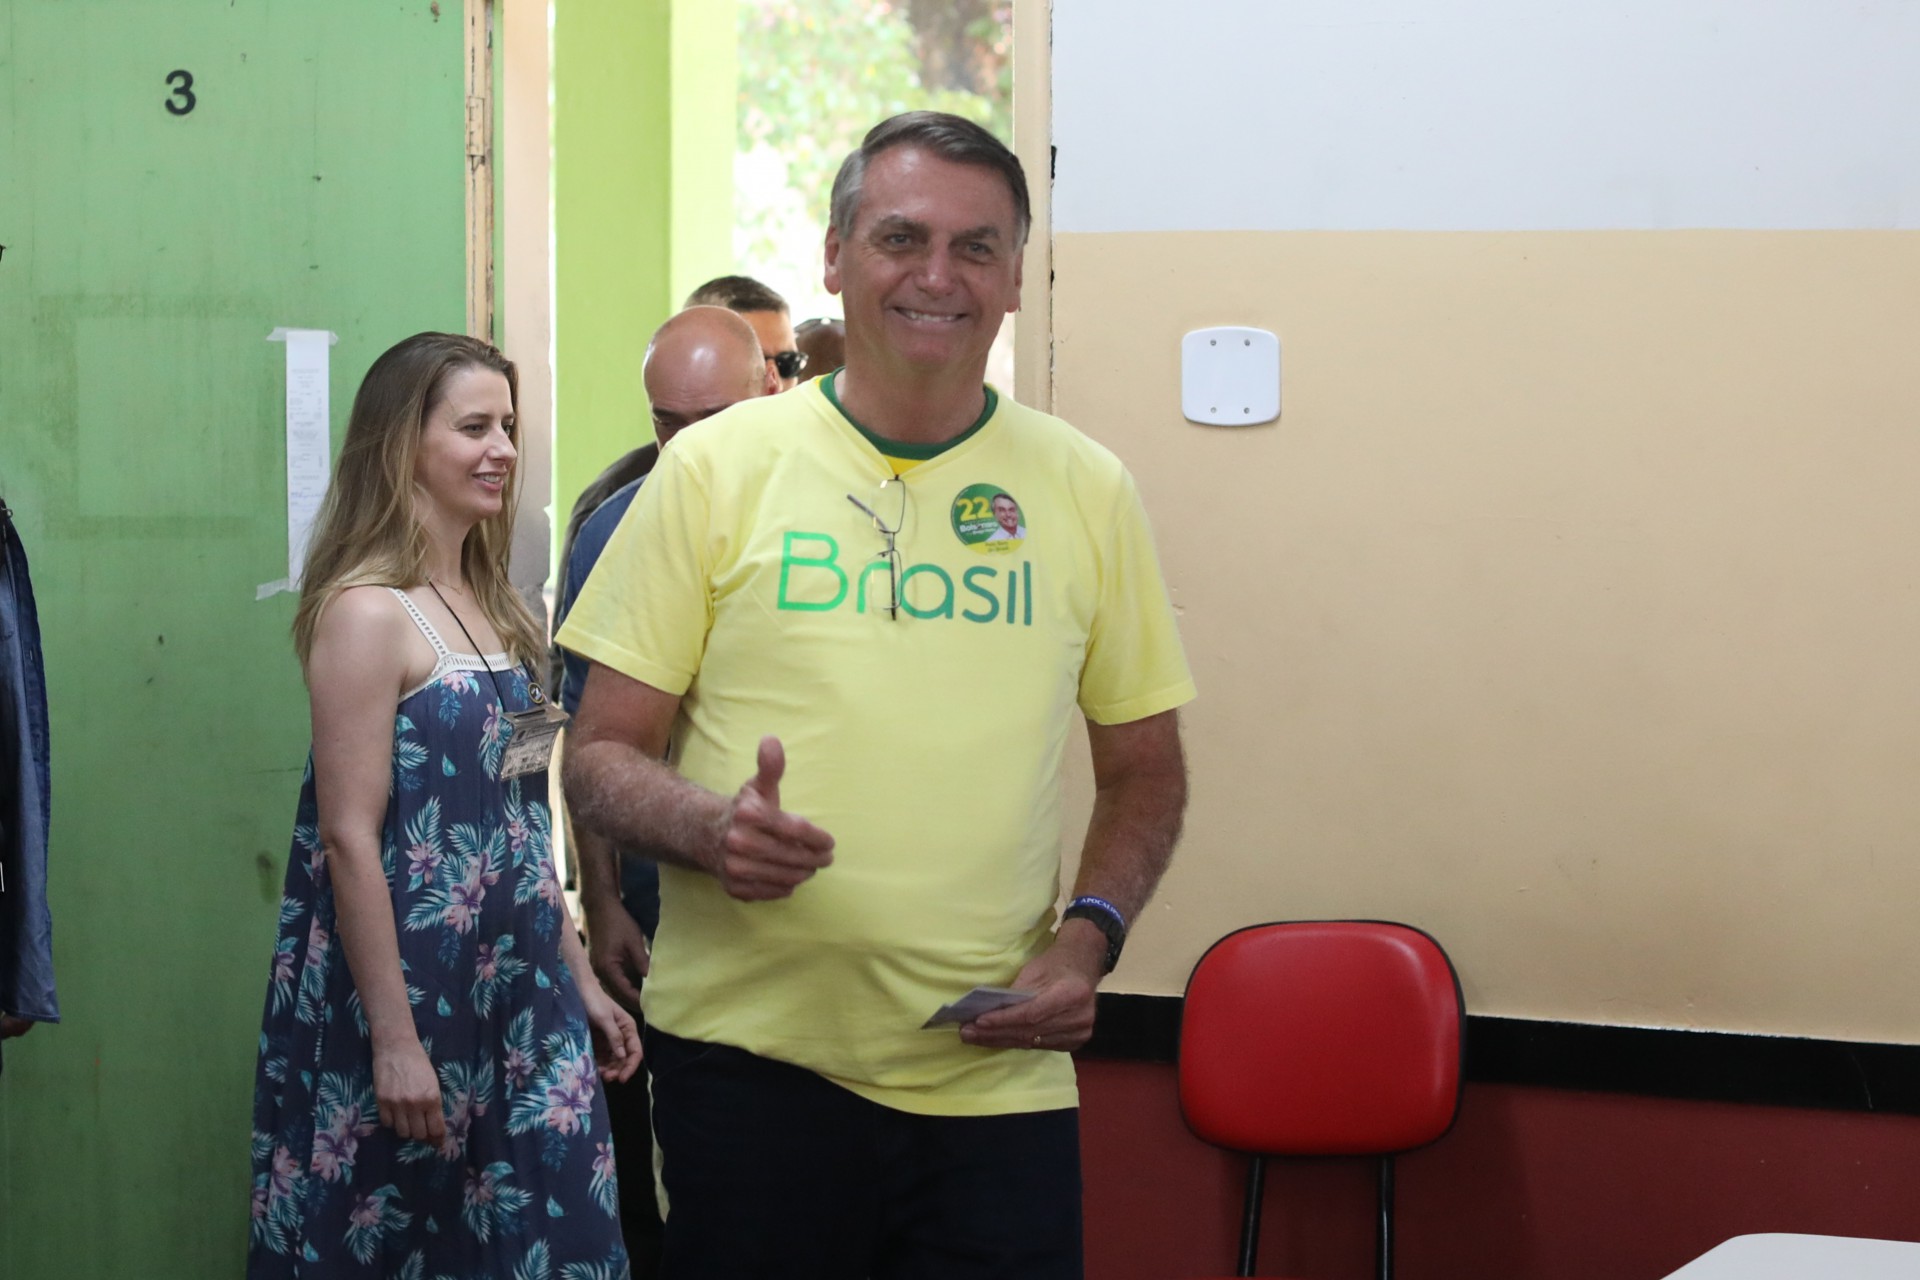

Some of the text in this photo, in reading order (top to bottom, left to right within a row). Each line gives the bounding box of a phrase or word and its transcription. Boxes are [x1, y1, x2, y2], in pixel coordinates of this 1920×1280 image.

[165, 69, 197, 116] 3
[957, 497, 993, 521] 22
[778, 531, 1031, 626] Brasil
